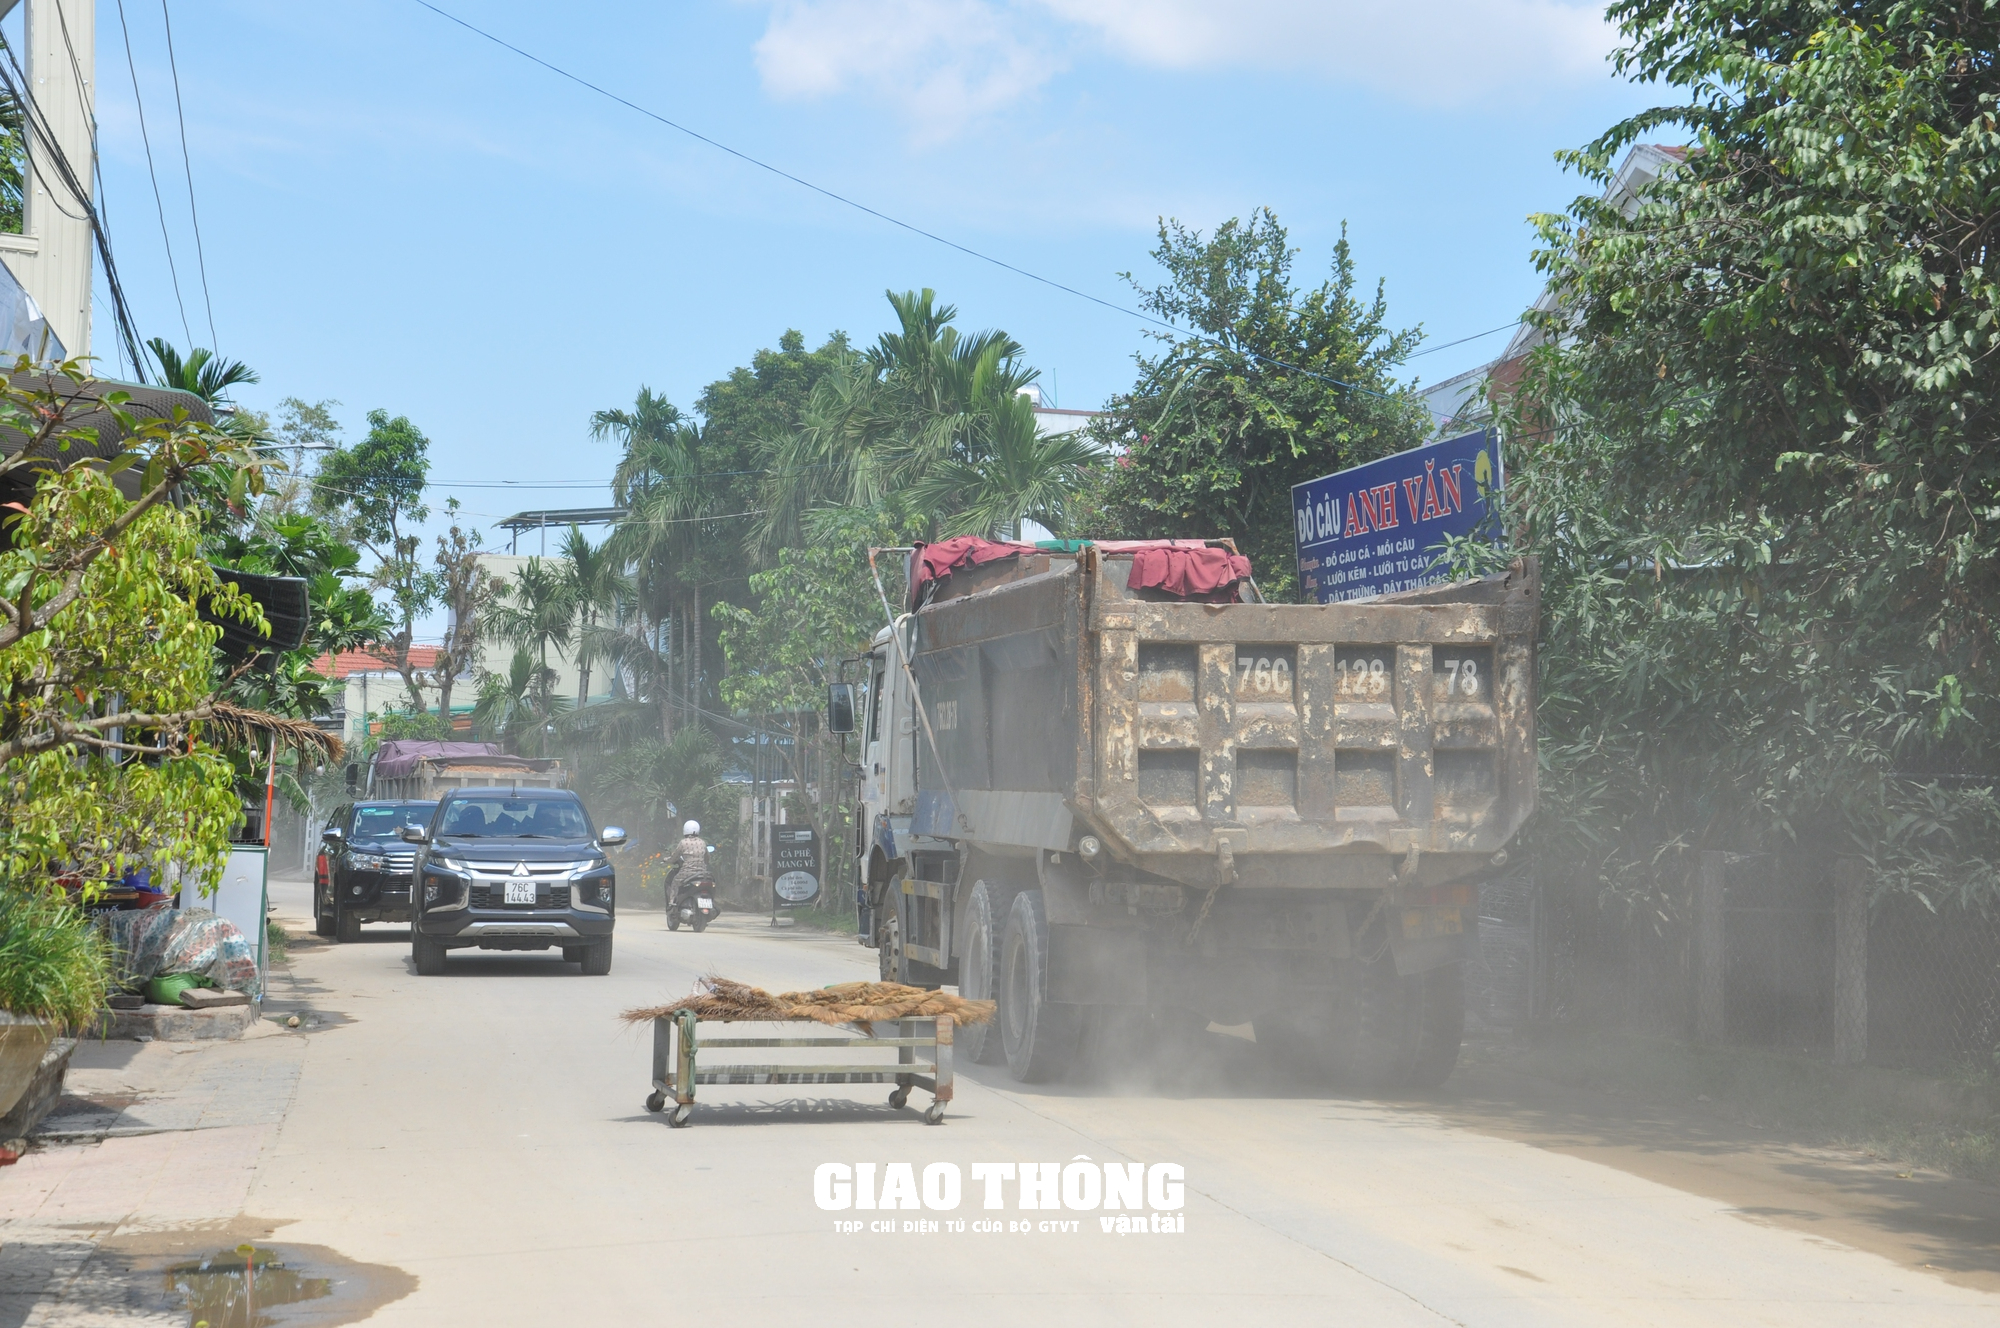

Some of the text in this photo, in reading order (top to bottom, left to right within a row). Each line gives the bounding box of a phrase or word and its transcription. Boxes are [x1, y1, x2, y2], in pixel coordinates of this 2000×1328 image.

[1297, 458, 1462, 543] ĐỒ CÂU ANH VĂN
[1339, 549, 1357, 565] CÂU
[1358, 545, 1370, 560] CÁ
[1396, 537, 1415, 554] CÂU
[1396, 556, 1409, 573] TỦ
[1410, 555, 1430, 570] CÂY
[1328, 590, 1345, 604] DÂY
[1383, 579, 1402, 594] DÂY
[1238, 657, 1478, 696] 76C 128 78
[780, 848, 811, 858] CÀ PHÊ
[776, 859, 803, 868] MANG
[512, 883, 528, 892] 76C
[506, 893, 535, 903] 144.43
